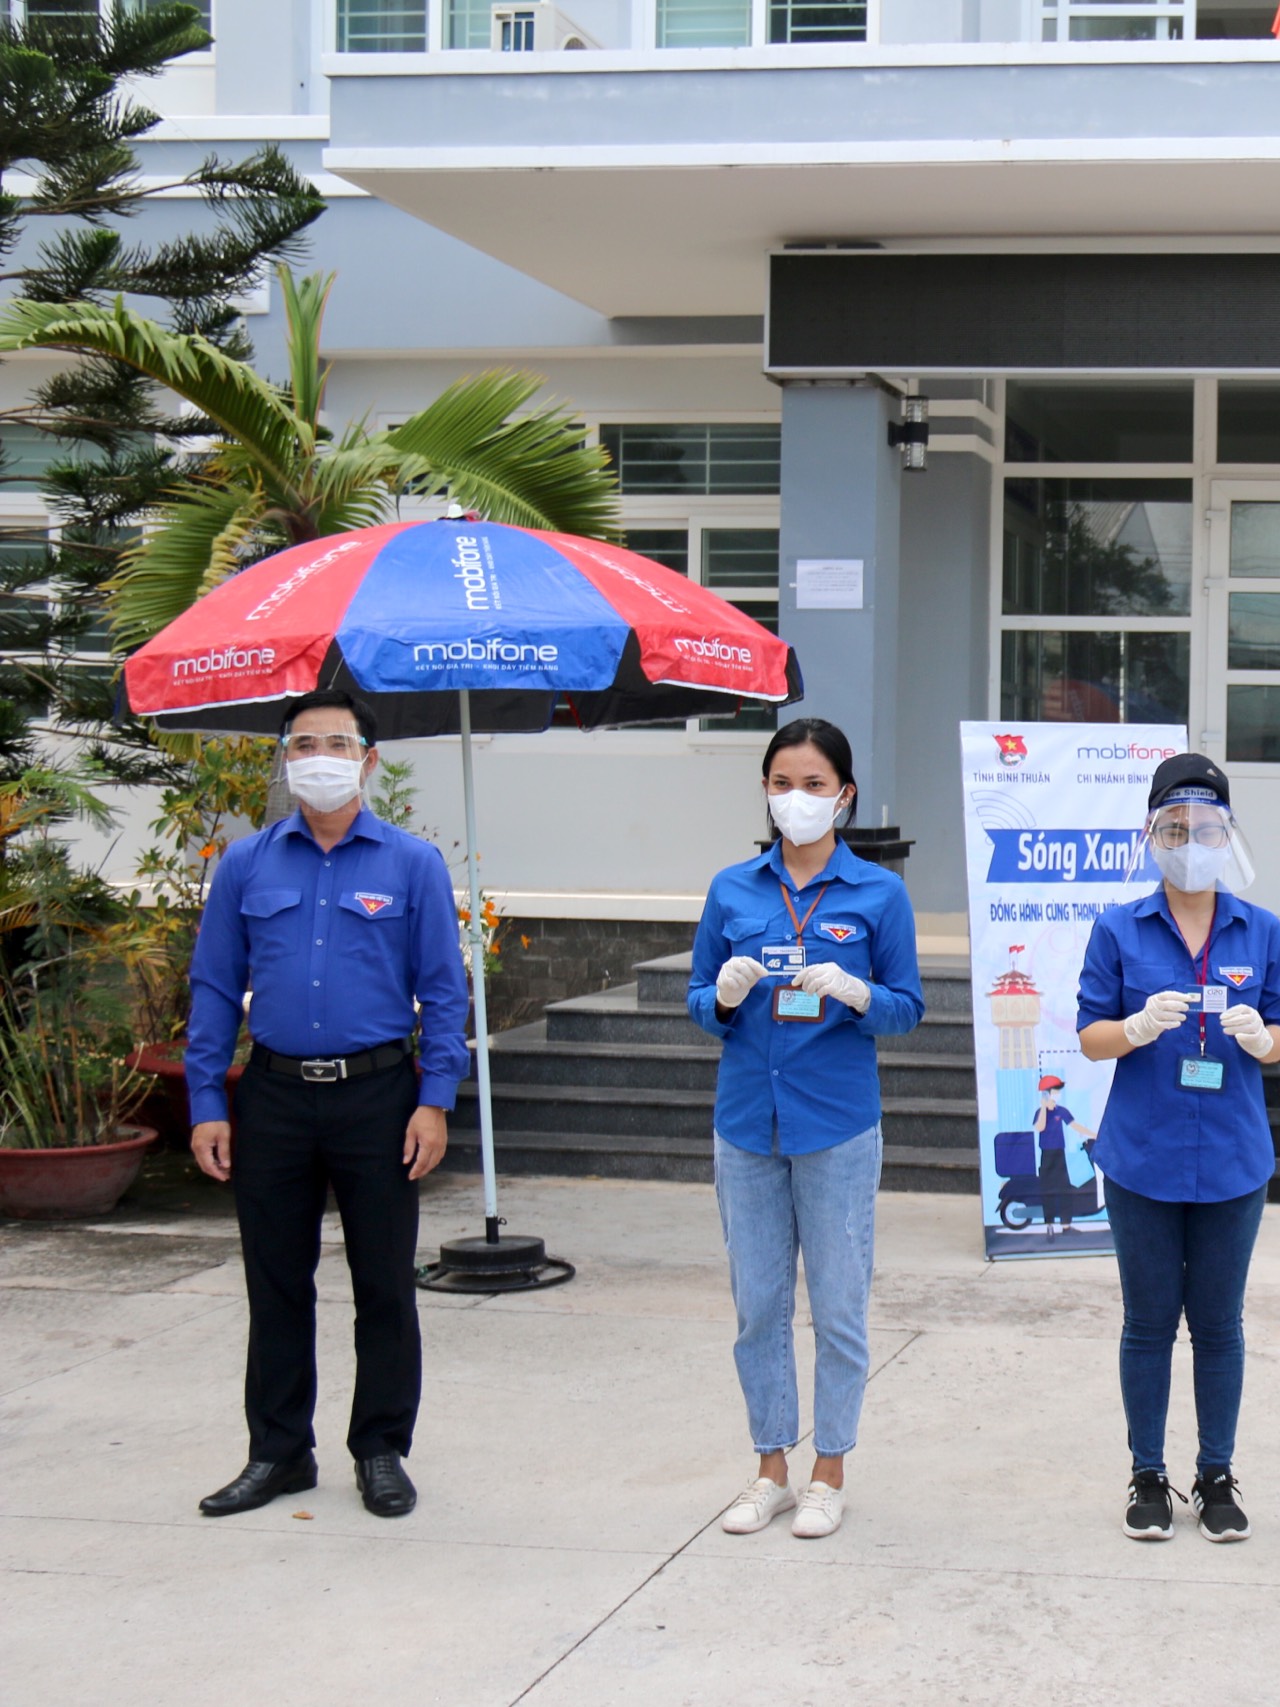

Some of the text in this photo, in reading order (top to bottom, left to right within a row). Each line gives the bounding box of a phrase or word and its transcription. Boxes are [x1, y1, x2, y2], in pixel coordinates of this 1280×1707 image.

[451, 536, 490, 610] mobifone
[413, 637, 559, 661] mobifone
[674, 635, 752, 664] mobifone
[173, 646, 276, 677] mobifone
[1077, 743, 1176, 759] mobifone
[973, 769, 1051, 786] TỈNH BÌNH THUẬN
[1077, 774, 1092, 784] CHI
[1094, 772, 1126, 784] NHÁNH
[1127, 772, 1149, 784] BÌNH
[1184, 788, 1214, 798] Shield
[1018, 831, 1145, 881] Sóng Xanh
[1045, 900, 1070, 921] CÙNG
[1072, 903, 1100, 921] THANH
[767, 958, 781, 968] 4G
